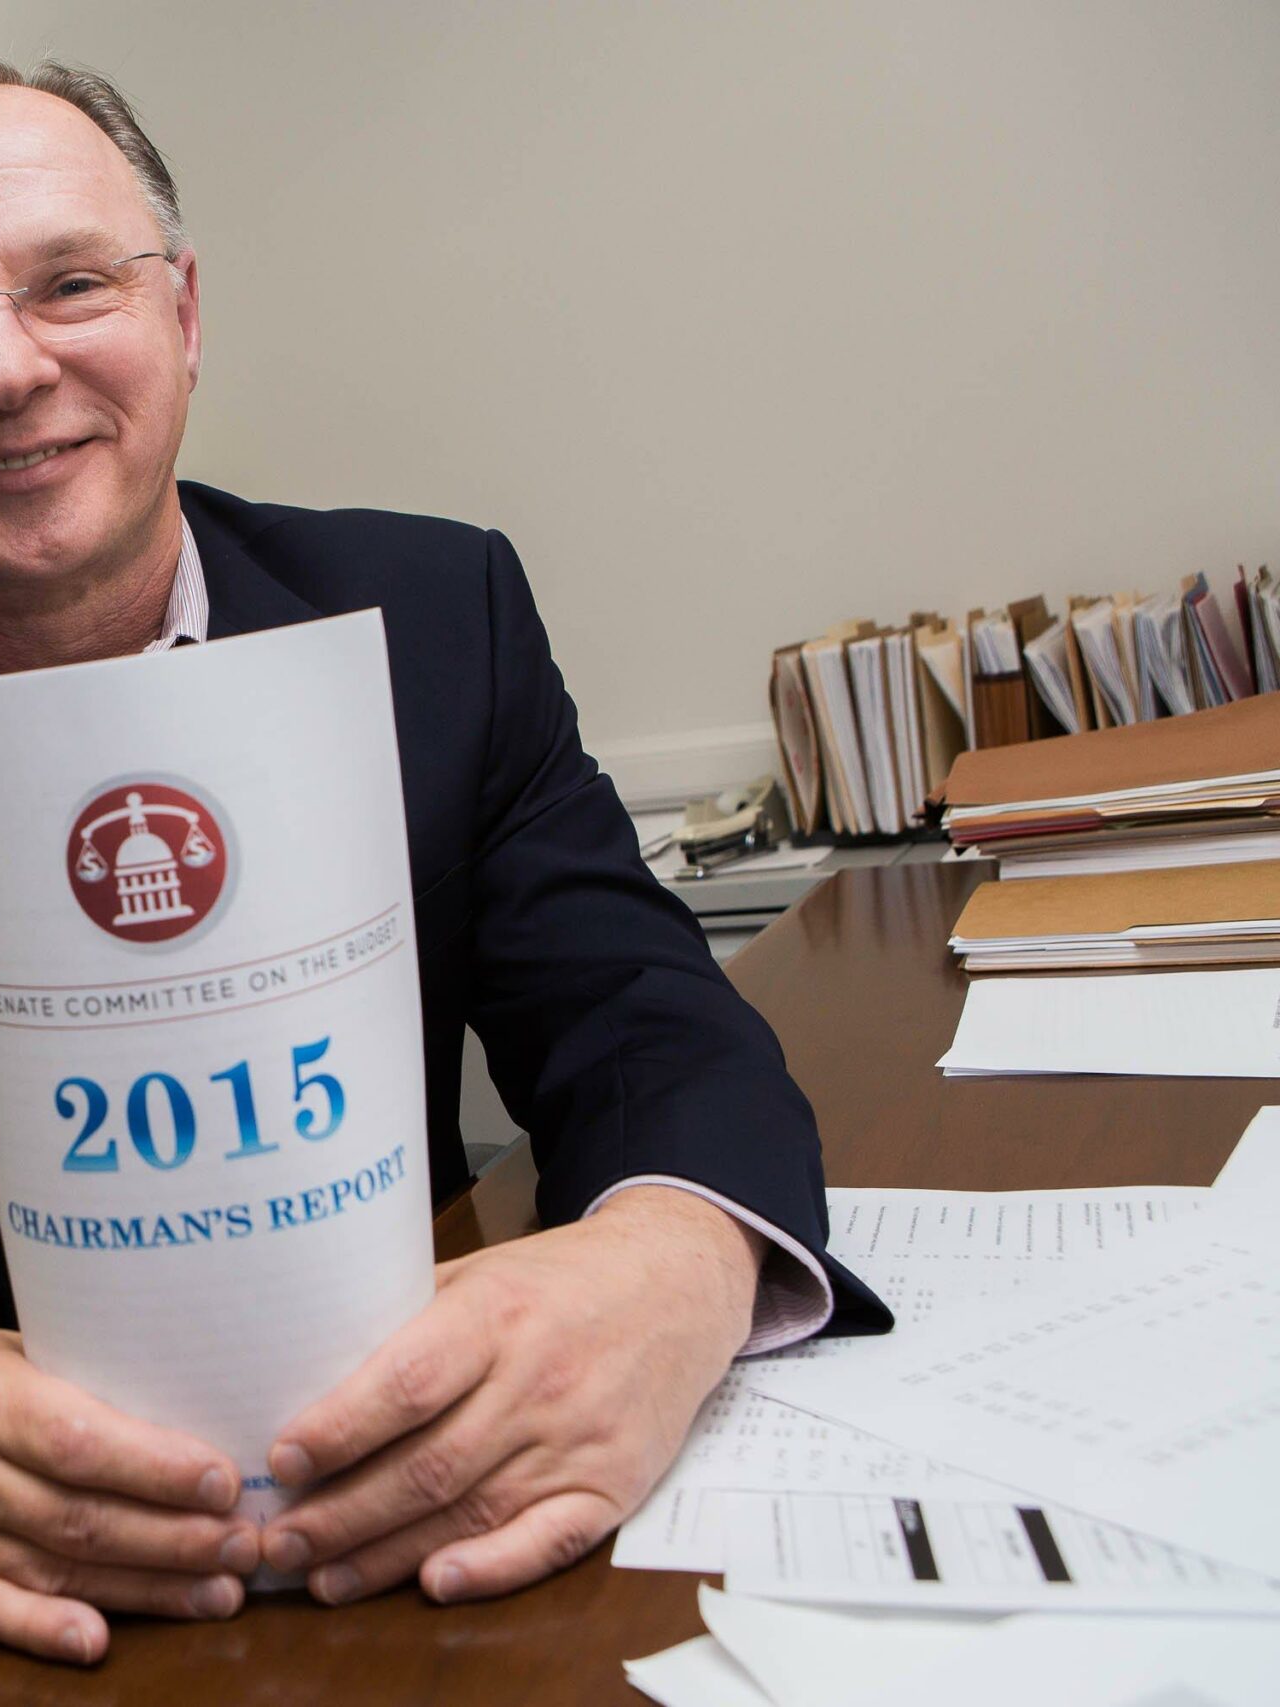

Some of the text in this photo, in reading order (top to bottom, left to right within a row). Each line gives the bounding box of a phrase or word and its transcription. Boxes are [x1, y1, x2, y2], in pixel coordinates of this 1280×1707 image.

[65, 977, 236, 1017] COMMITTEE
[248, 967, 287, 992] ON
[298, 948, 338, 978] THE
[345, 916, 398, 961] BUDGET
[54, 1036, 346, 1172] 2015
[8, 1144, 406, 1250] CHAIRMAN'S REPORT
